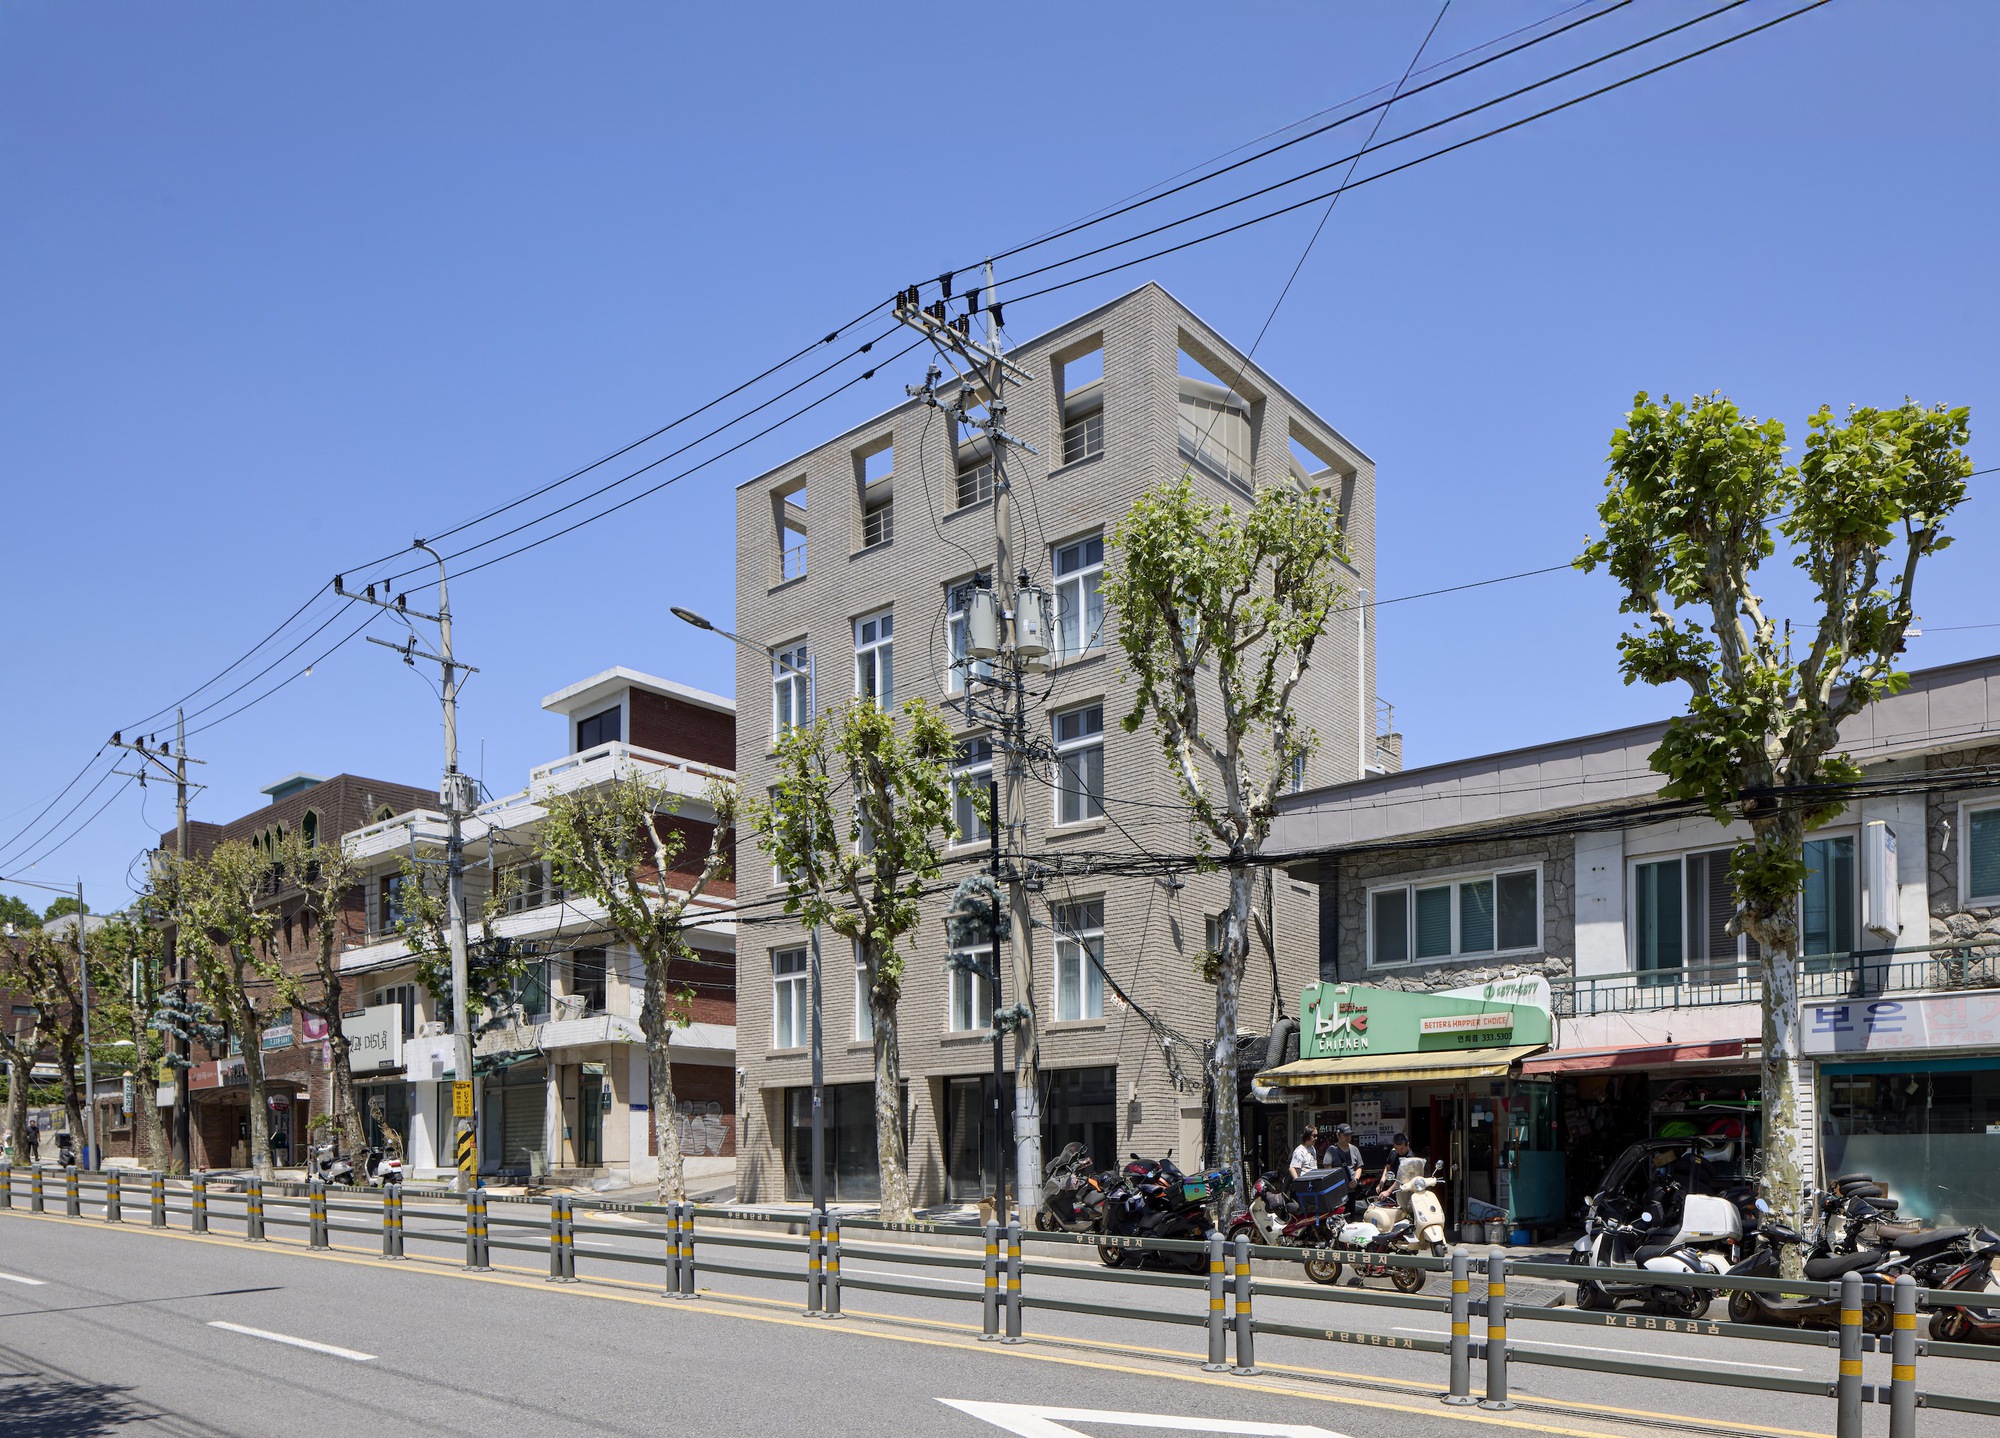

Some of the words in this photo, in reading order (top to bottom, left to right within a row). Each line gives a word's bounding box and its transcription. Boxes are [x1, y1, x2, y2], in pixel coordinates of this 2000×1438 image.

[1483, 1016, 1507, 1026] CHOICE
[1812, 1001, 1907, 1034] 보은
[1319, 1038, 1368, 1051] CHICKEN
[1457, 1034, 1478, 1044] 연희점
[1482, 1032, 1512, 1042] 333.5303
[1859, 1029, 1993, 1048] 3142-5746
[1075, 1234, 1142, 1249] 무단횡단금지
[1301, 1249, 1388, 1265] 무단횡단금지
[1324, 1330, 1413, 1349] 무단횡단금지
